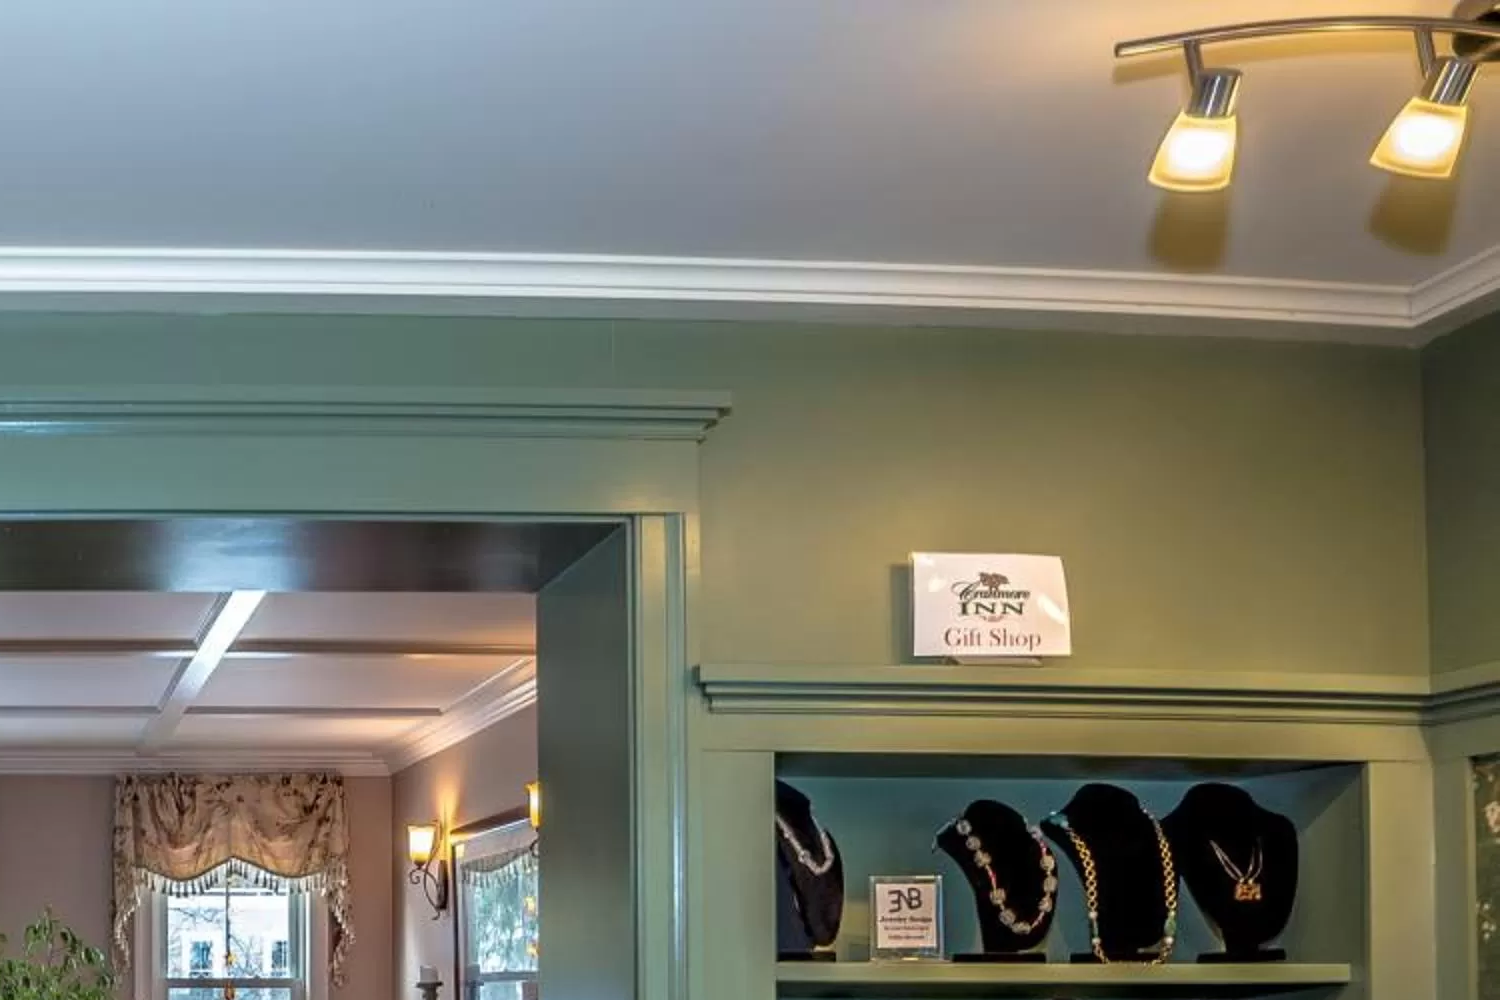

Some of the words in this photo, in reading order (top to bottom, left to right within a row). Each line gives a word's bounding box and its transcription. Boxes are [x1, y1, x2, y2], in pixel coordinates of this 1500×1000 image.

[951, 580, 1032, 602] Cranmore
[957, 601, 1025, 617] INN
[943, 627, 982, 648] Gift
[988, 627, 1043, 652] Shop
